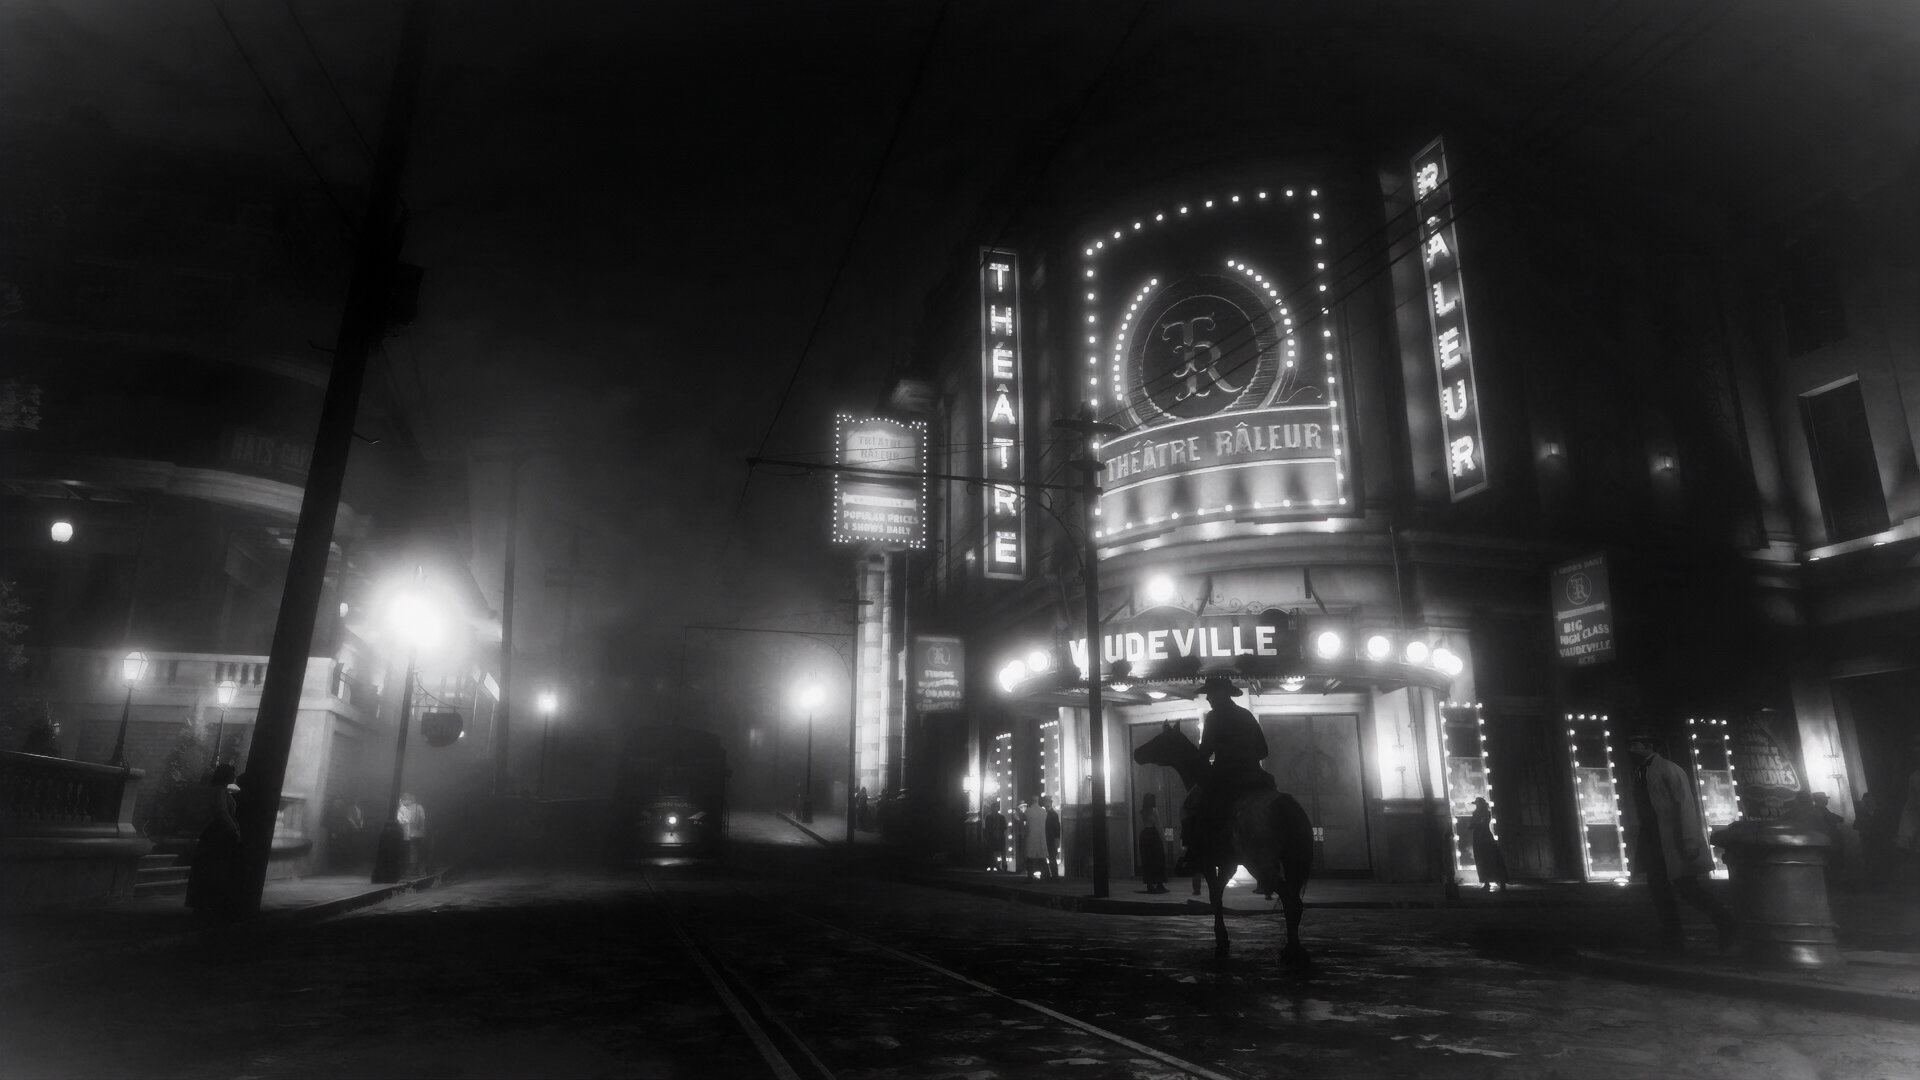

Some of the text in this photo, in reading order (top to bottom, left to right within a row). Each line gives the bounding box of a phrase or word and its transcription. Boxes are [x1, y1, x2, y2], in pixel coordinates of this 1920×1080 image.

[989, 262, 1016, 563] THÉÂTRE
[1104, 421, 1322, 482] THÉÂTRE RÂLEUR
[887, 525, 911, 536] DAILY
[888, 514, 919, 525] PRICES
[1560, 623, 1610, 645] HIGH CLASS
[1564, 619, 1583, 633] BIG
[1069, 625, 1278, 669] VUDEVILLE
